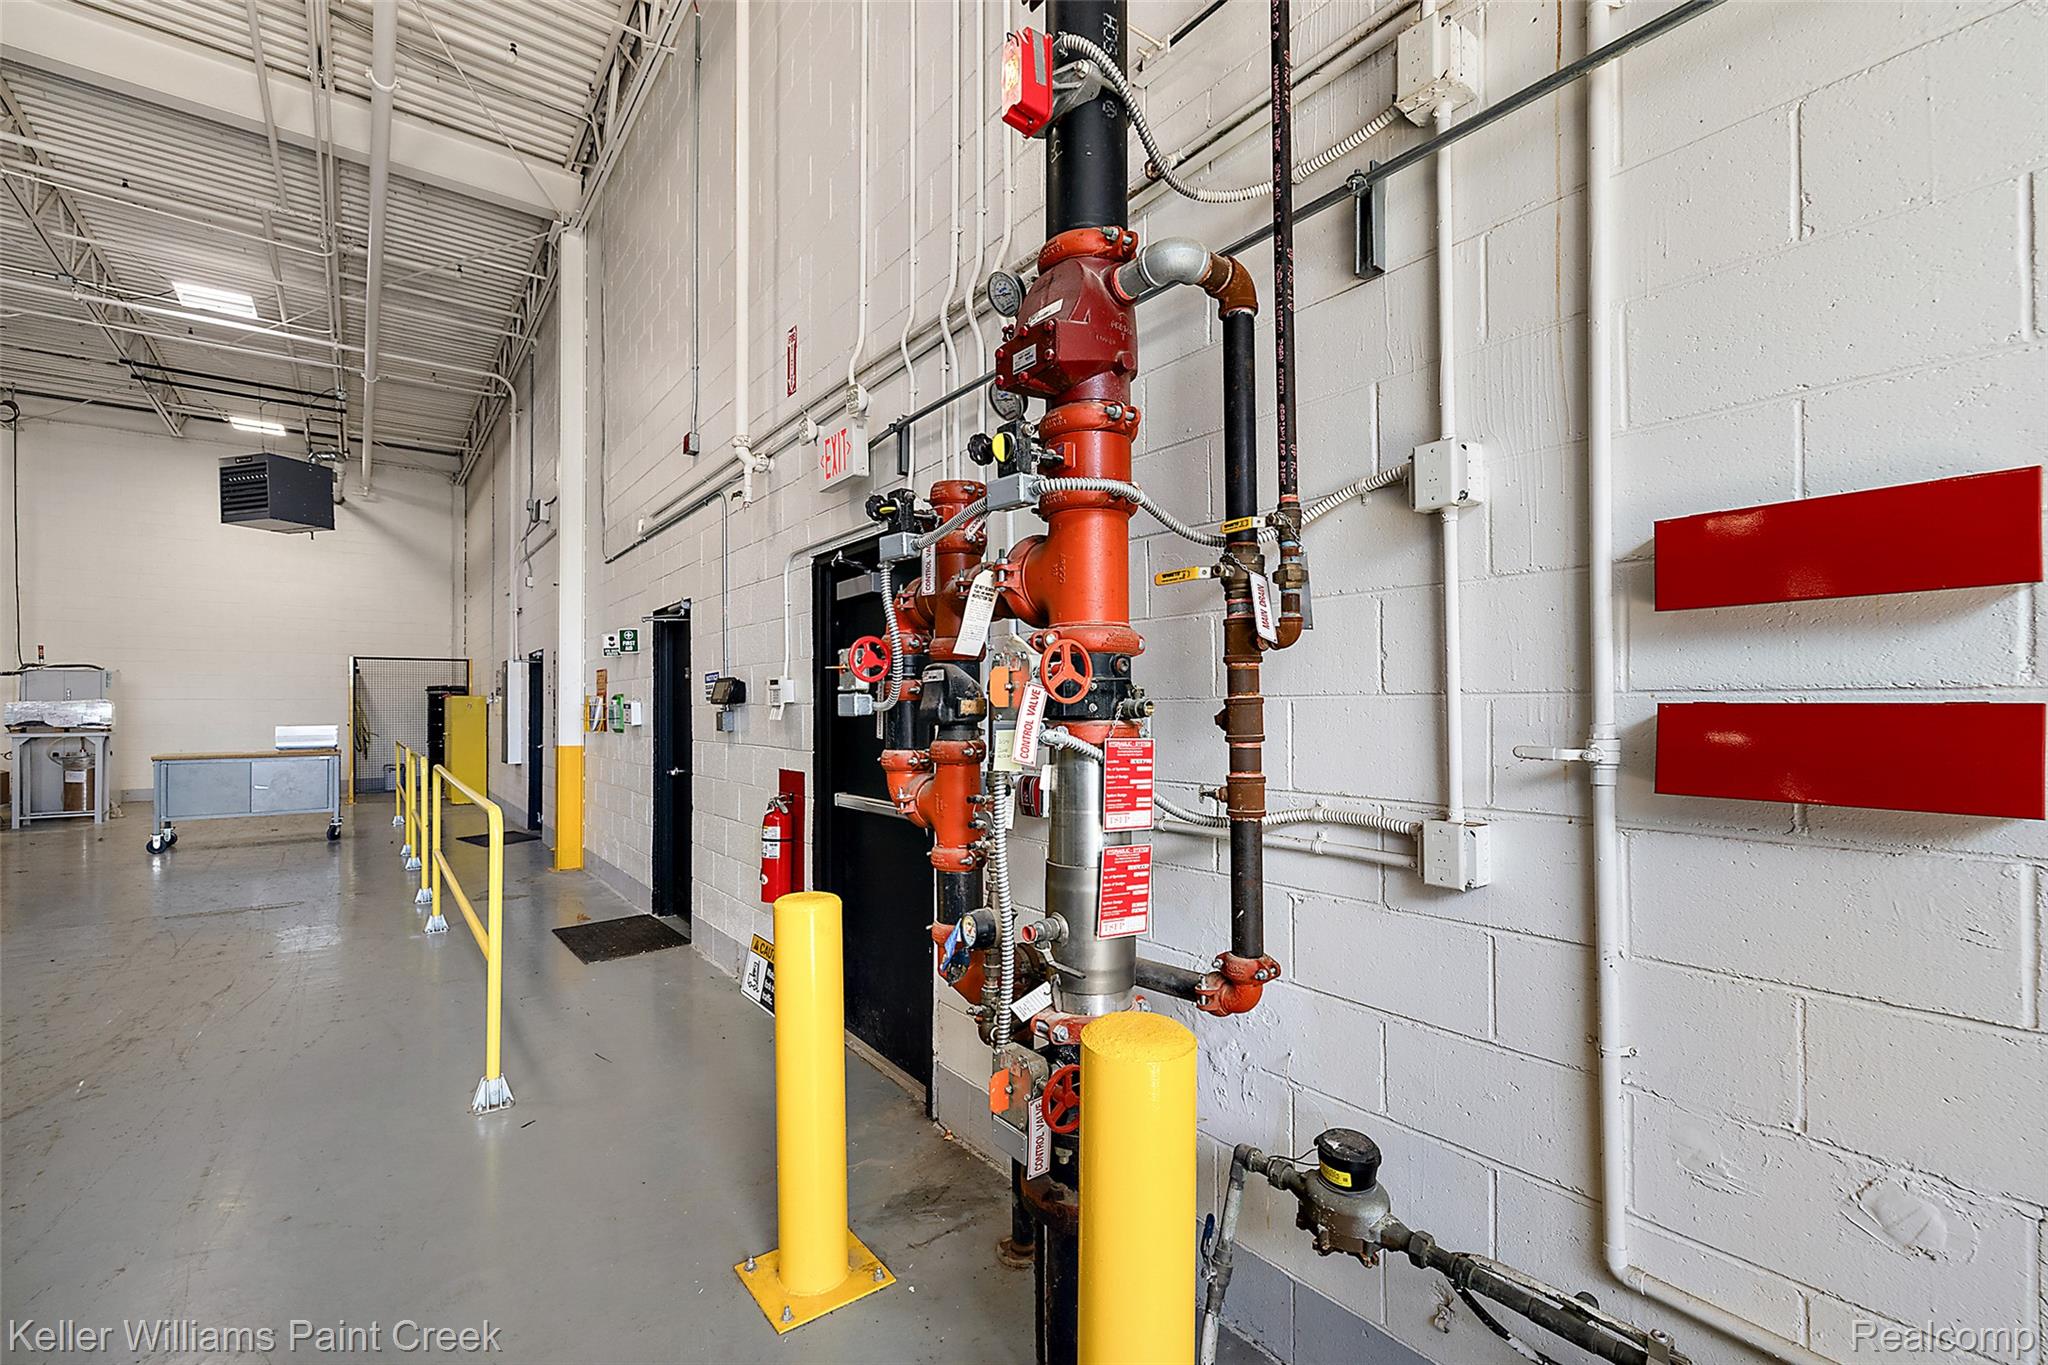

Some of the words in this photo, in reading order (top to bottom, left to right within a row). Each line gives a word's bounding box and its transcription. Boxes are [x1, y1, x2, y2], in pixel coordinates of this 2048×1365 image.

[1103, 12, 1119, 56] SCH
[824, 428, 848, 480] EXIT
[1257, 583, 1266, 607] DRAIN
[1260, 608, 1270, 630] MAIN
[1026, 688, 1041, 716] VALVE
[1020, 719, 1034, 759] CONTROL
[760, 942, 775, 960] CAUT
[1035, 1132, 1045, 1172] CONTROL
